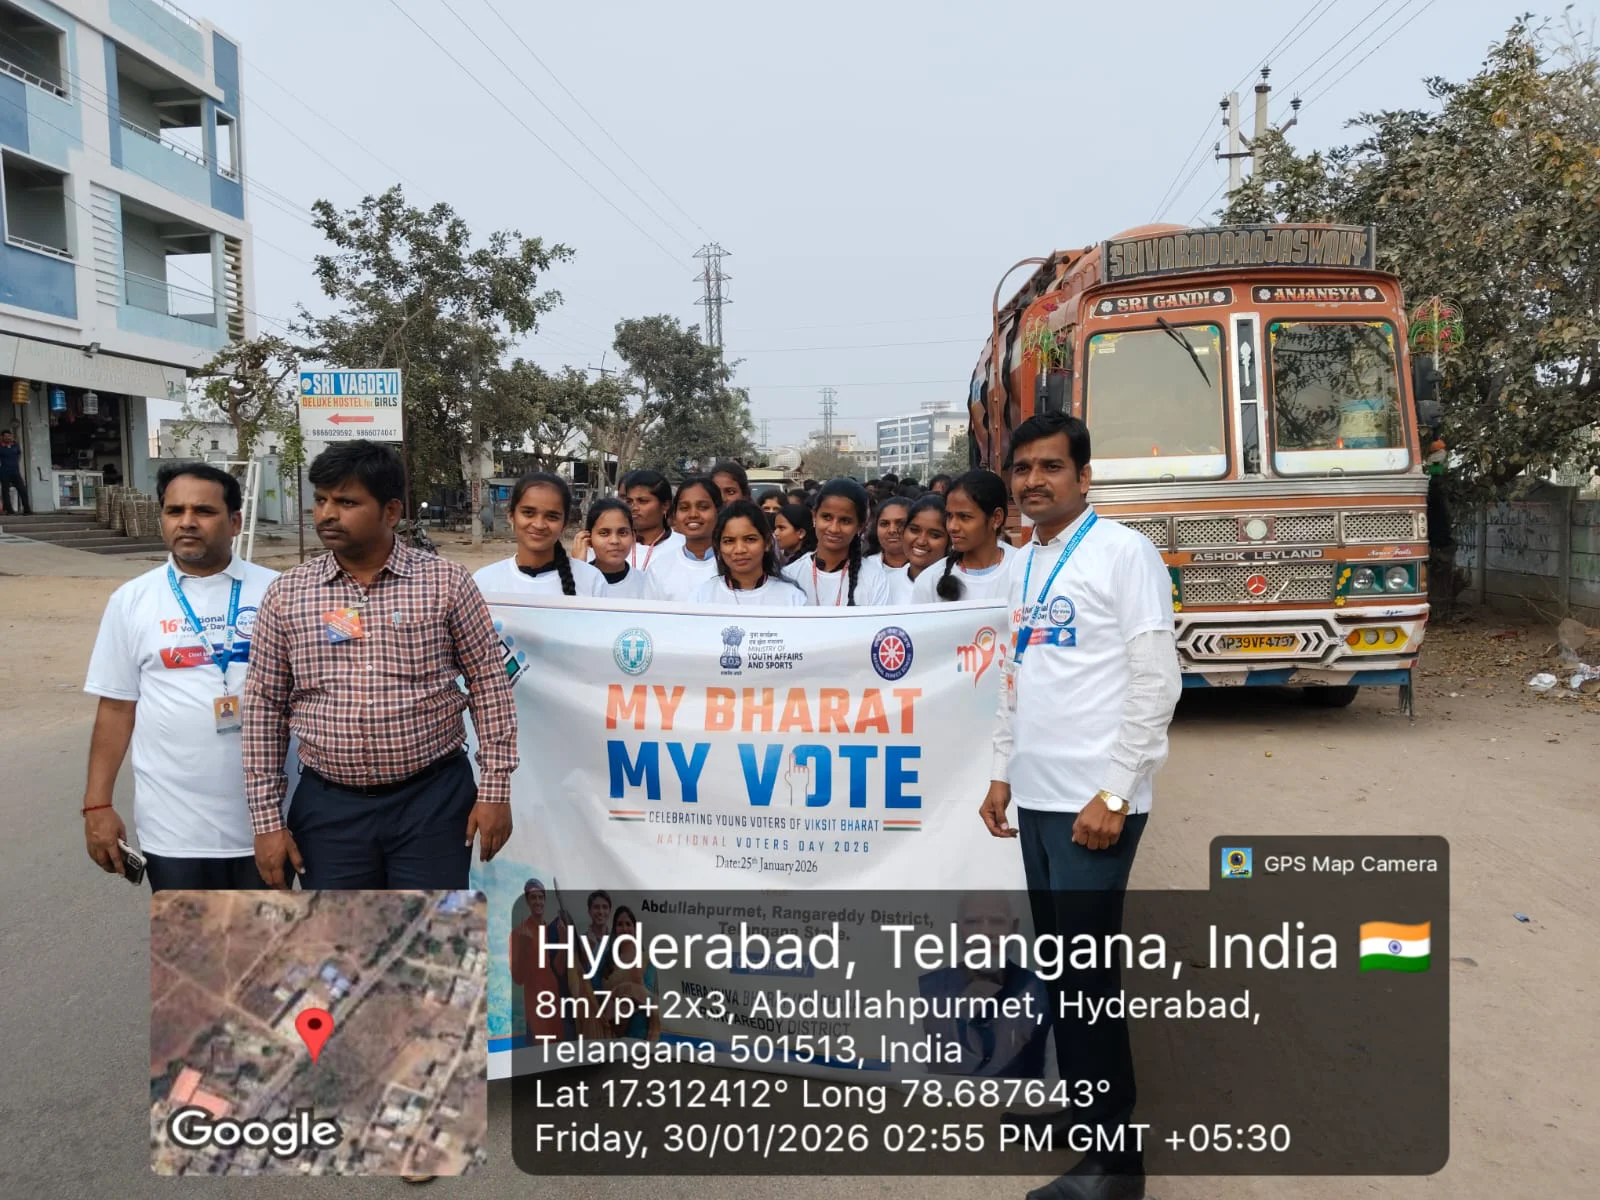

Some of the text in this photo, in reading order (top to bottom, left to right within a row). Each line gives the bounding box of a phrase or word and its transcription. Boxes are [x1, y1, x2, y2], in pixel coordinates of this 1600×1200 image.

[1117, 290, 1212, 313] SRI GANDI
[1274, 287, 1361, 301] ANJANEYA
[313, 373, 398, 394] SRI VAGDEVI
[302, 397, 331, 407] DELUXE
[333, 397, 362, 407] HOSTEL
[374, 397, 398, 407] GIRLS
[1193, 549, 1322, 562] ASHOK LEYLAND
[211, 623, 226, 631] Day
[748, 653, 804, 661] YOUTH AFFAIRS
[605, 684, 923, 735] MY BHARAT
[607, 740, 922, 809] MY VOTE
[649, 811, 880, 832] CELEBRATING YOUNG VOTERS OF VIKSIT BHARAT
[657, 833, 869, 853] NATIONAL VOTERS DAY 2026
[759, 856, 794, 875] January
[795, 860, 818, 873] 2026
[641, 899, 935, 929] Abdullahpurmet, Rangareddy District,
